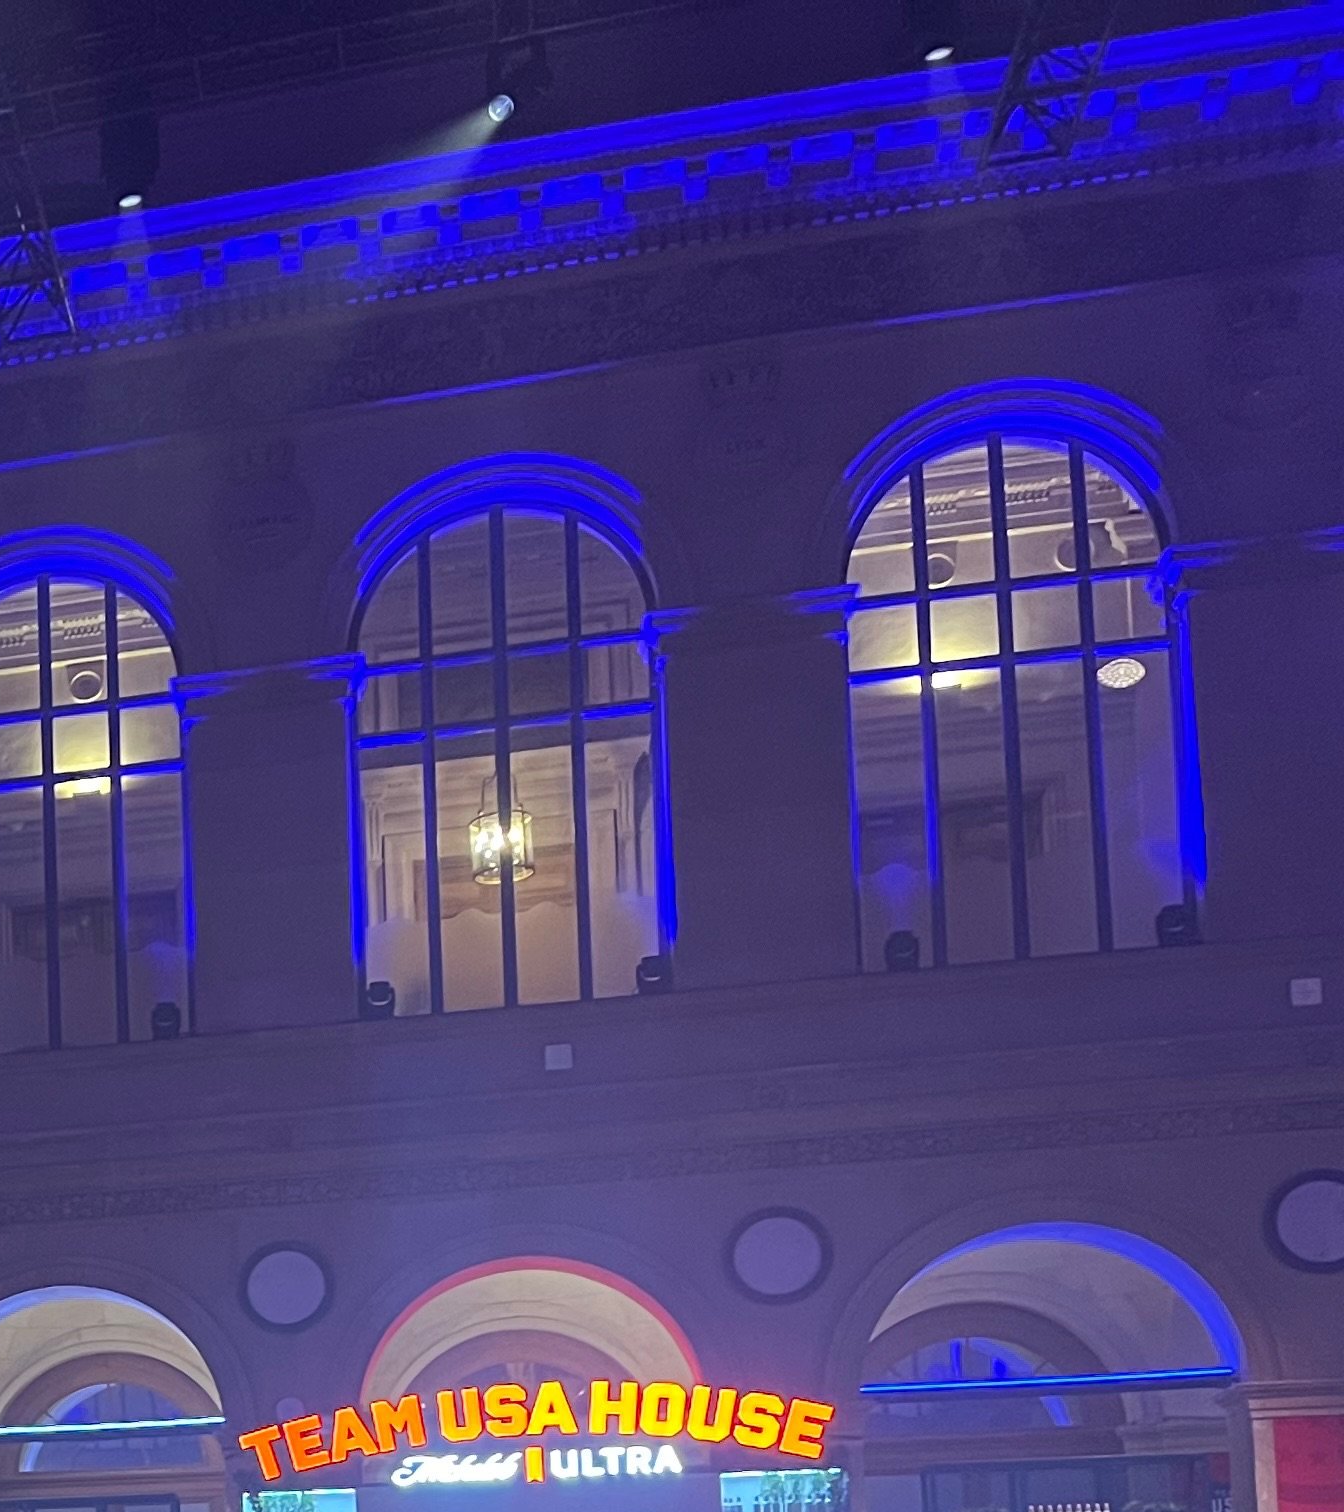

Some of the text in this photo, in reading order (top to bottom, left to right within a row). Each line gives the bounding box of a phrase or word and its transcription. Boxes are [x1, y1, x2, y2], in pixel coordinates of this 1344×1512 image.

[238, 1379, 836, 1483] TEAM USA HOUSE
[550, 1444, 683, 1479] ULTRA
